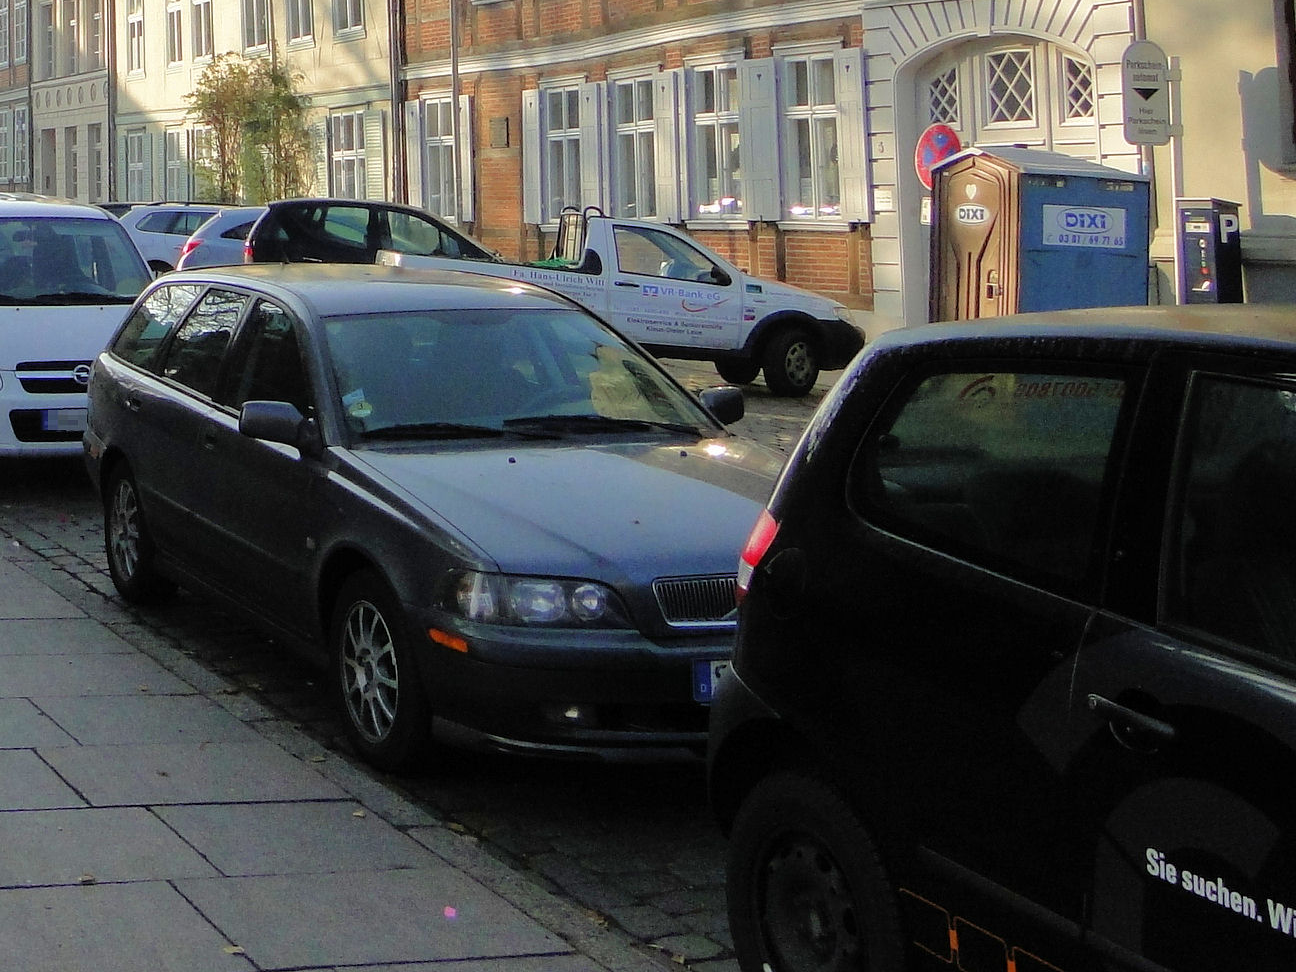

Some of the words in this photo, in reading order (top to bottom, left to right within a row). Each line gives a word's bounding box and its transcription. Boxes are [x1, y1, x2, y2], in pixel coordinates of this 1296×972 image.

[1219, 214, 1238, 243] P
[1145, 847, 1177, 884] Sie
[1181, 870, 1263, 923] suchen.
